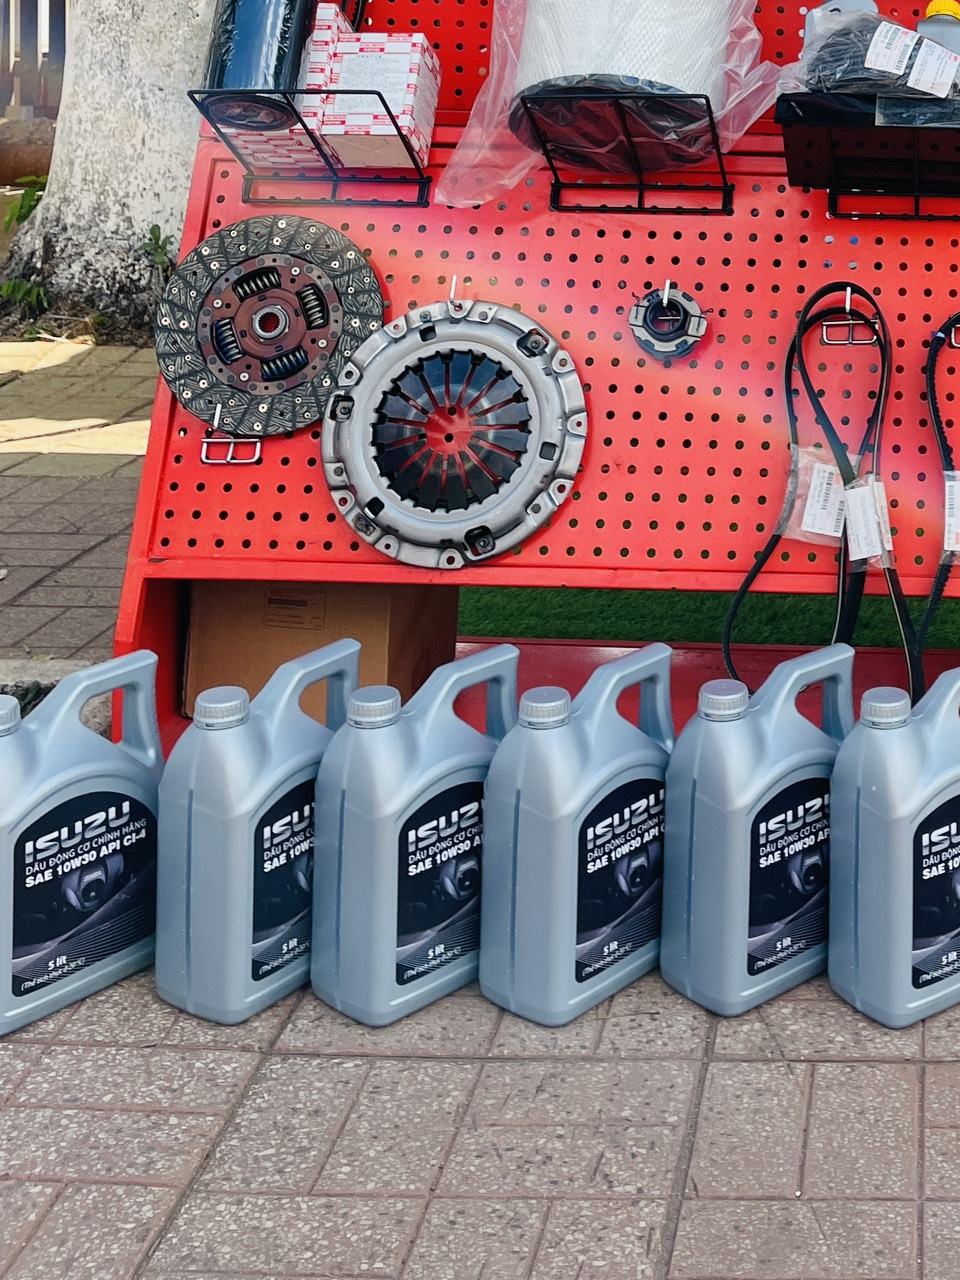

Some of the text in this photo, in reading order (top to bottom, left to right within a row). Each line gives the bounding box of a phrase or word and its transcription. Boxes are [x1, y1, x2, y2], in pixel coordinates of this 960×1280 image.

[25, 801, 130, 864] ISUZU
[263, 801, 317, 849] ISU
[408, 799, 484, 853] ISUZ
[759, 827, 831, 868] SAE 10W30 AP
[25, 869, 53, 888] SAE
[56, 850, 97, 876] 10W30
[99, 839, 121, 858] API
[263, 836, 316, 873] SAE 10W3
[408, 857, 433, 876] SAE
[435, 839, 472, 864] 10W30
[587, 854, 609, 874] SAE
[610, 836, 642, 861] 10W30
[642, 826, 659, 843] API
[922, 862, 946, 880] SAE
